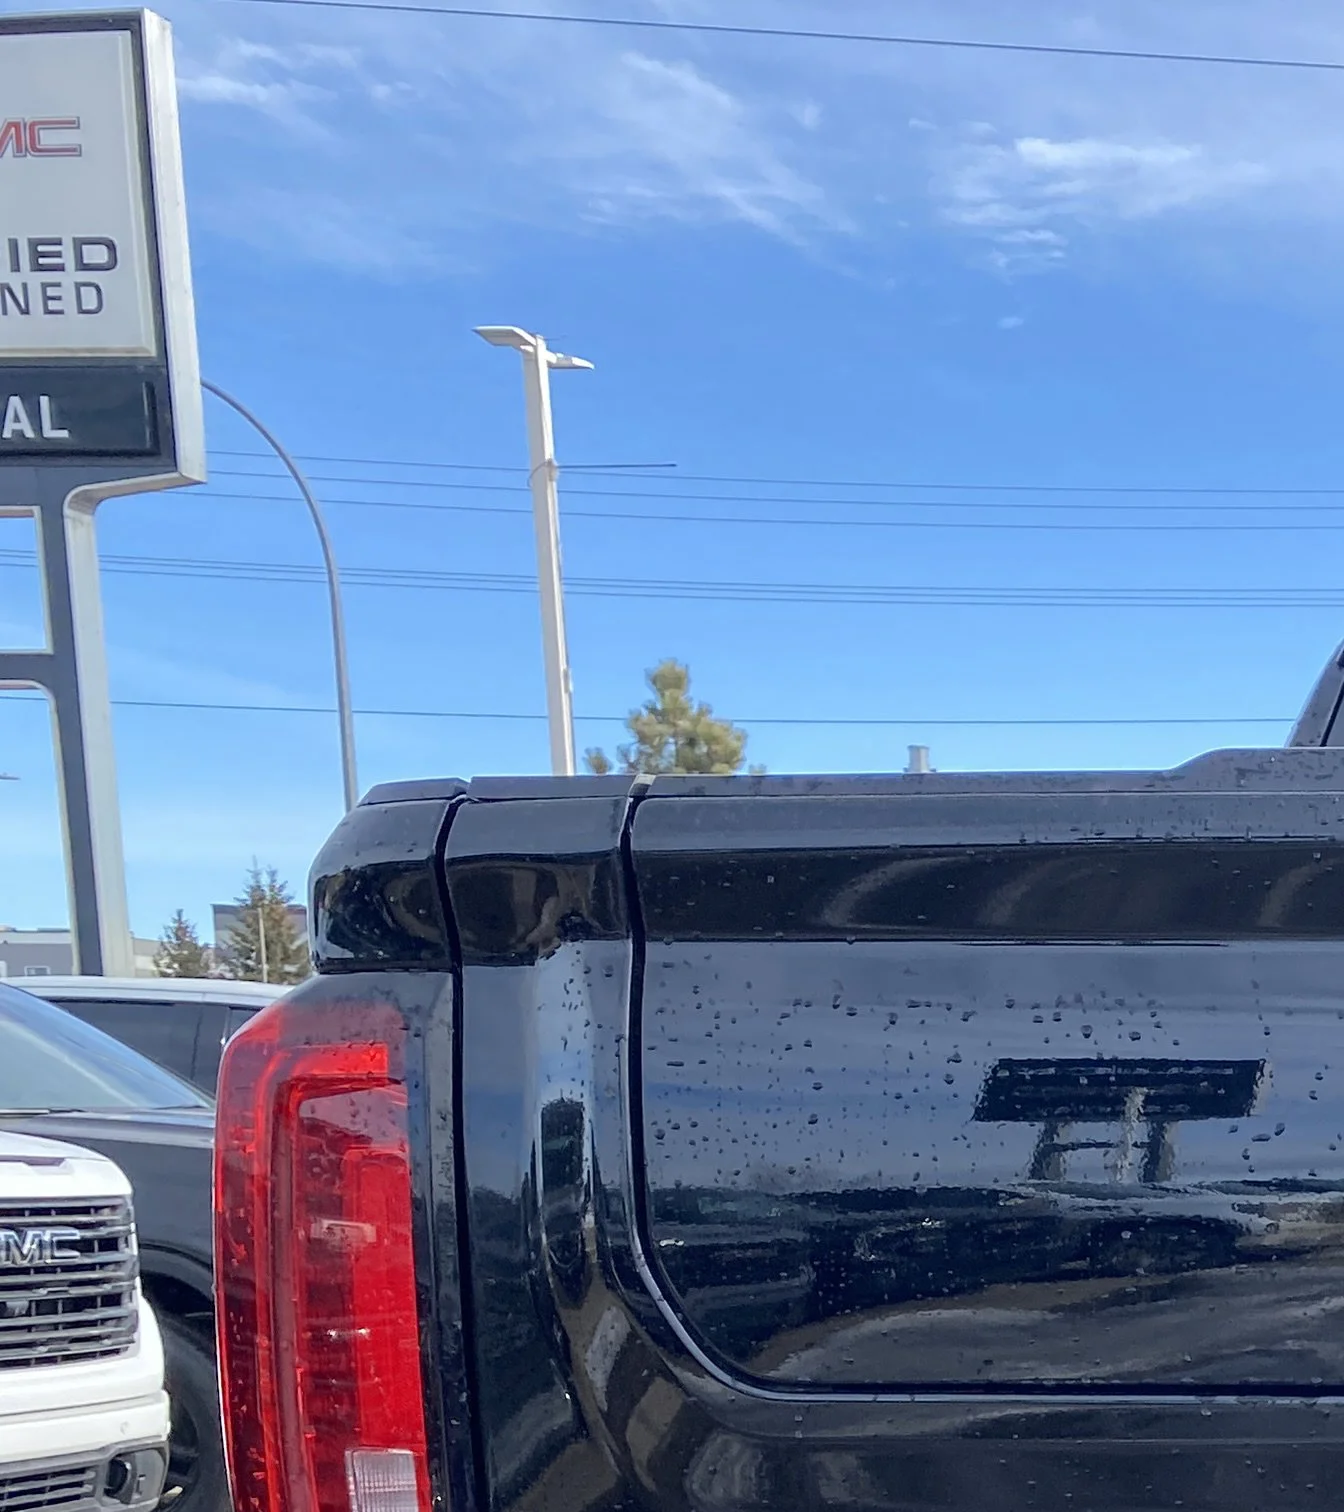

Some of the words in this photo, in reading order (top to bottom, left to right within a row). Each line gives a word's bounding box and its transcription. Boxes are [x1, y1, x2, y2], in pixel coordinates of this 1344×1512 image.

[7, 236, 118, 273] IED
[0, 281, 103, 316] NED
[2, 394, 70, 439] AL
